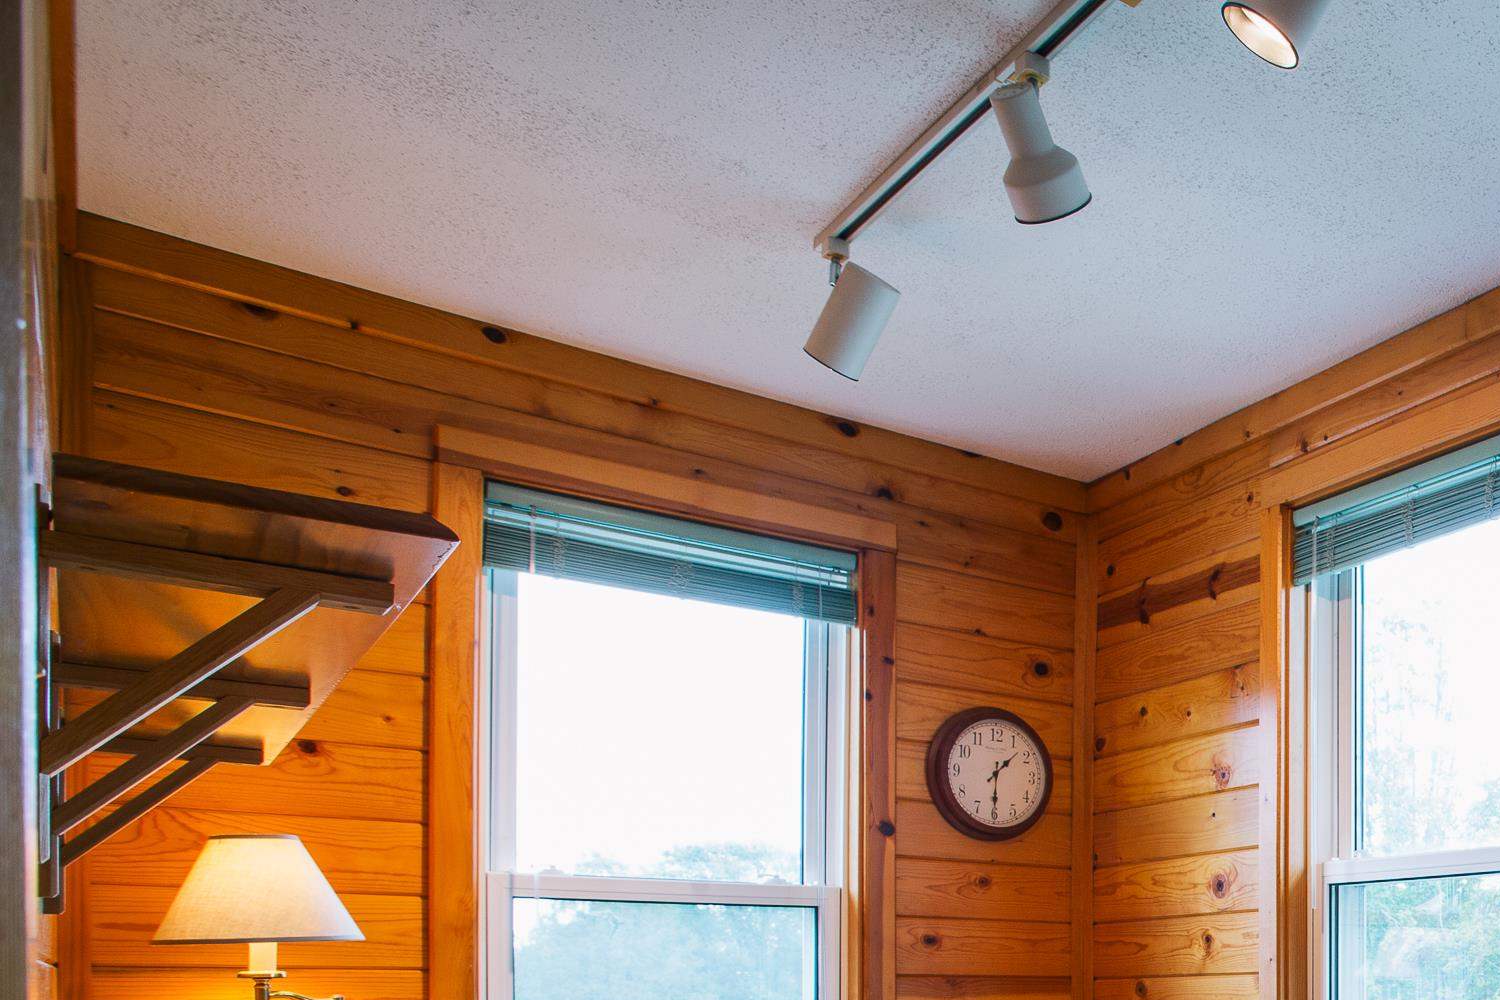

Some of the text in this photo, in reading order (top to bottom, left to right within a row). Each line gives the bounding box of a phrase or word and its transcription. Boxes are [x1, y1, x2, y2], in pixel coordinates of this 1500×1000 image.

[973, 731, 982, 746] 11
[991, 728, 1003, 742] 12
[1011, 735, 1016, 748] 1
[959, 744, 971, 758] 10
[1023, 751, 1030, 764] 2
[953, 763, 960, 777] 9
[1028, 771, 1035, 785] 3
[958, 784, 966, 798] 8
[1022, 790, 1030, 803] 4
[974, 800, 981, 814] 7
[991, 806, 998, 820] 6
[1009, 804, 1017, 817] 5
